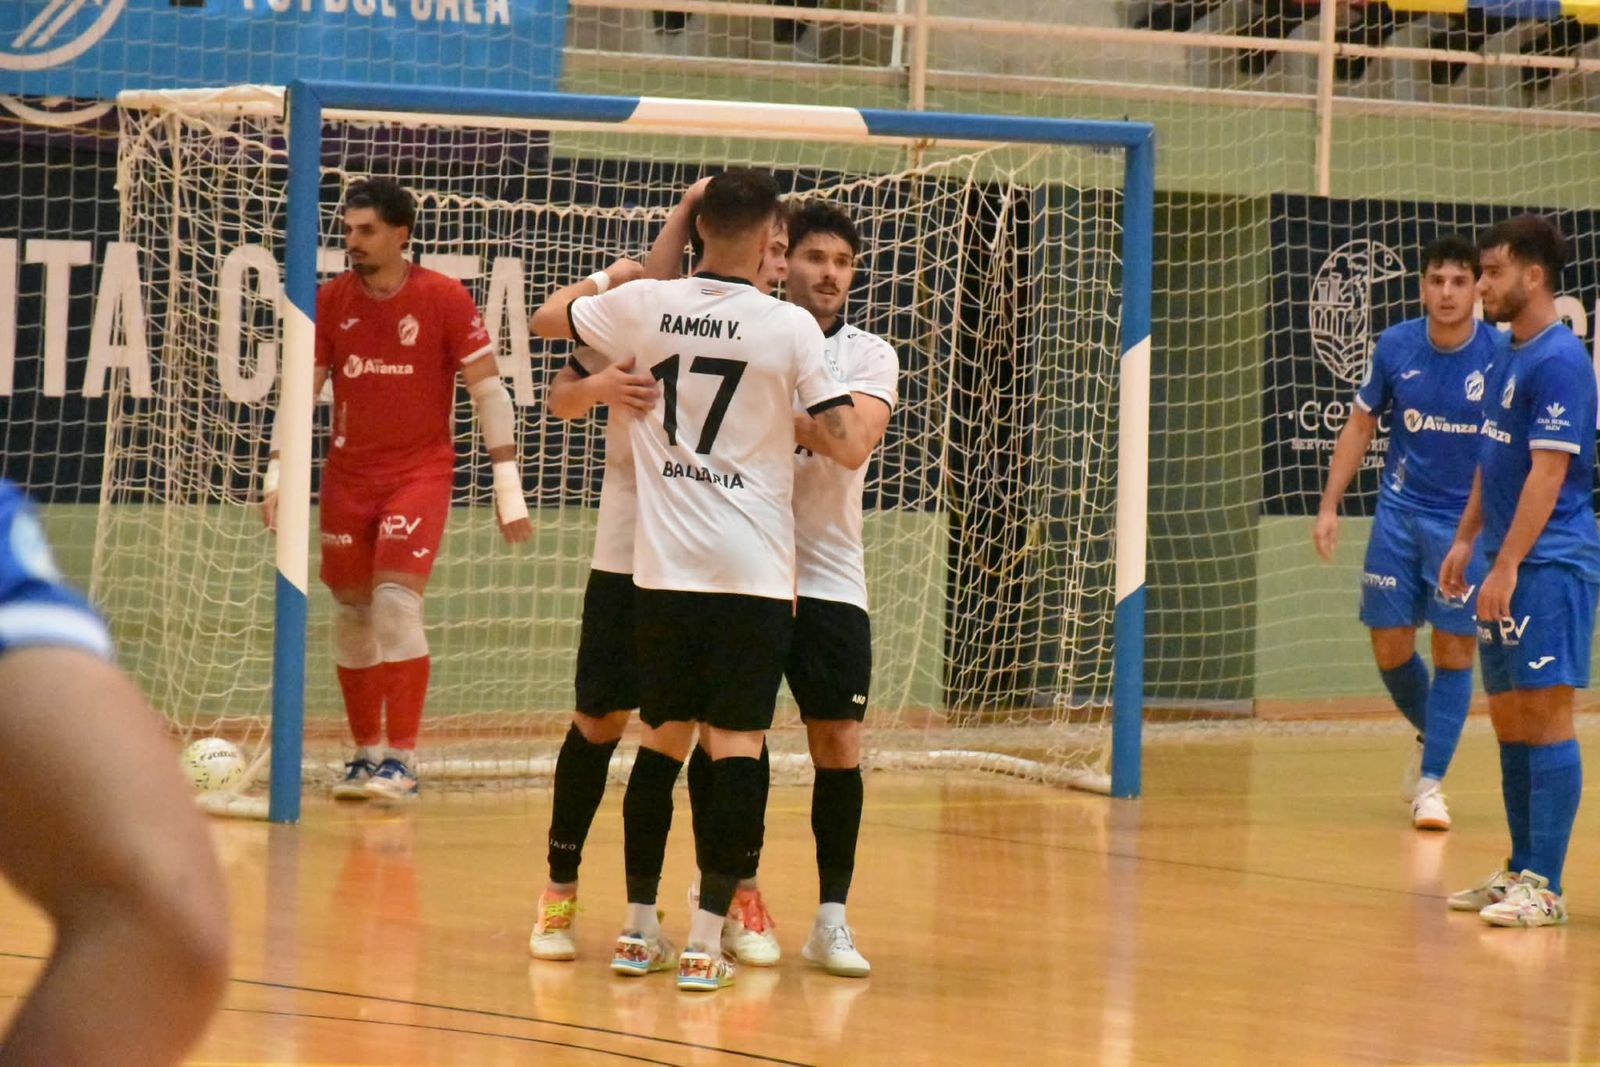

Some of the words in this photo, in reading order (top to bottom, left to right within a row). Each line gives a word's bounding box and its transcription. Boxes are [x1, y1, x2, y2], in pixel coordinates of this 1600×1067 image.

[660, 314, 722, 338] RAMÓN
[728, 321, 741, 340] V.
[650, 354, 748, 455] 17
